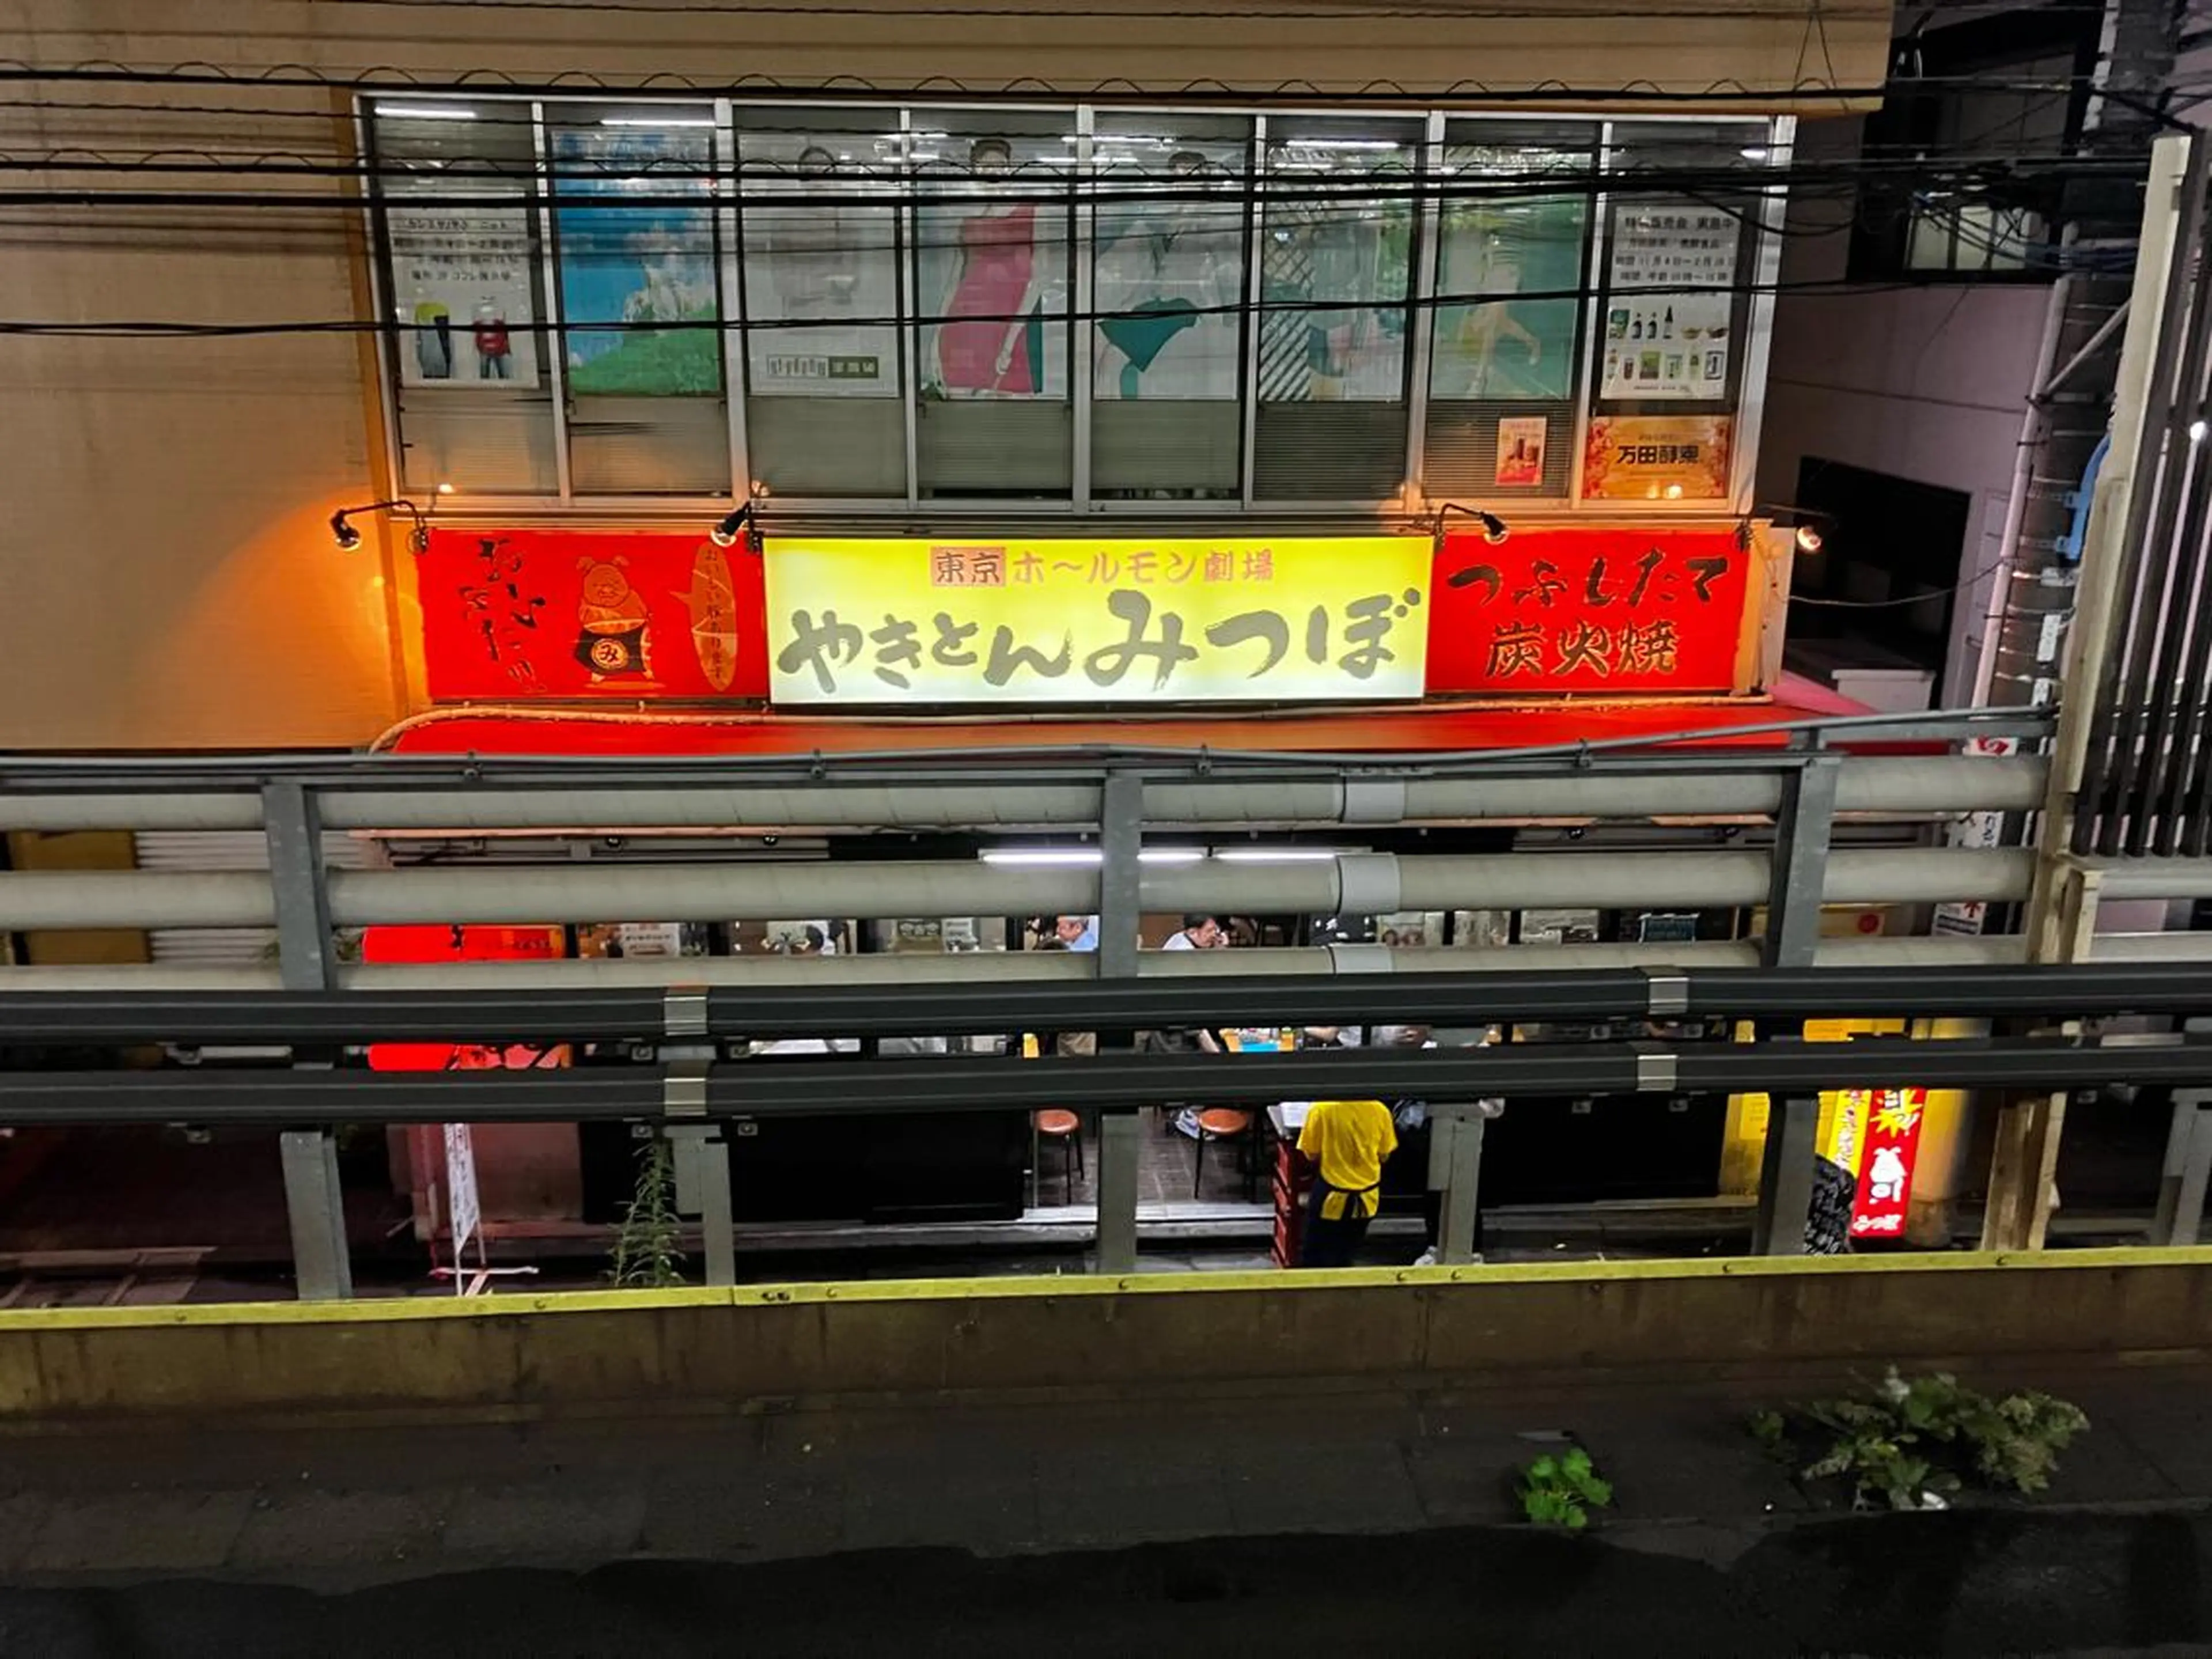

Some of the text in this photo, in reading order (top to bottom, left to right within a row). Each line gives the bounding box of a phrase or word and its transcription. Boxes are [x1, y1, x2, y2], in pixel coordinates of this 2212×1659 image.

[935, 552, 1001, 584] 東京
[777, 588, 1422, 694] やきとんみつぼ
[1485, 620, 1680, 679] 炭火焼
